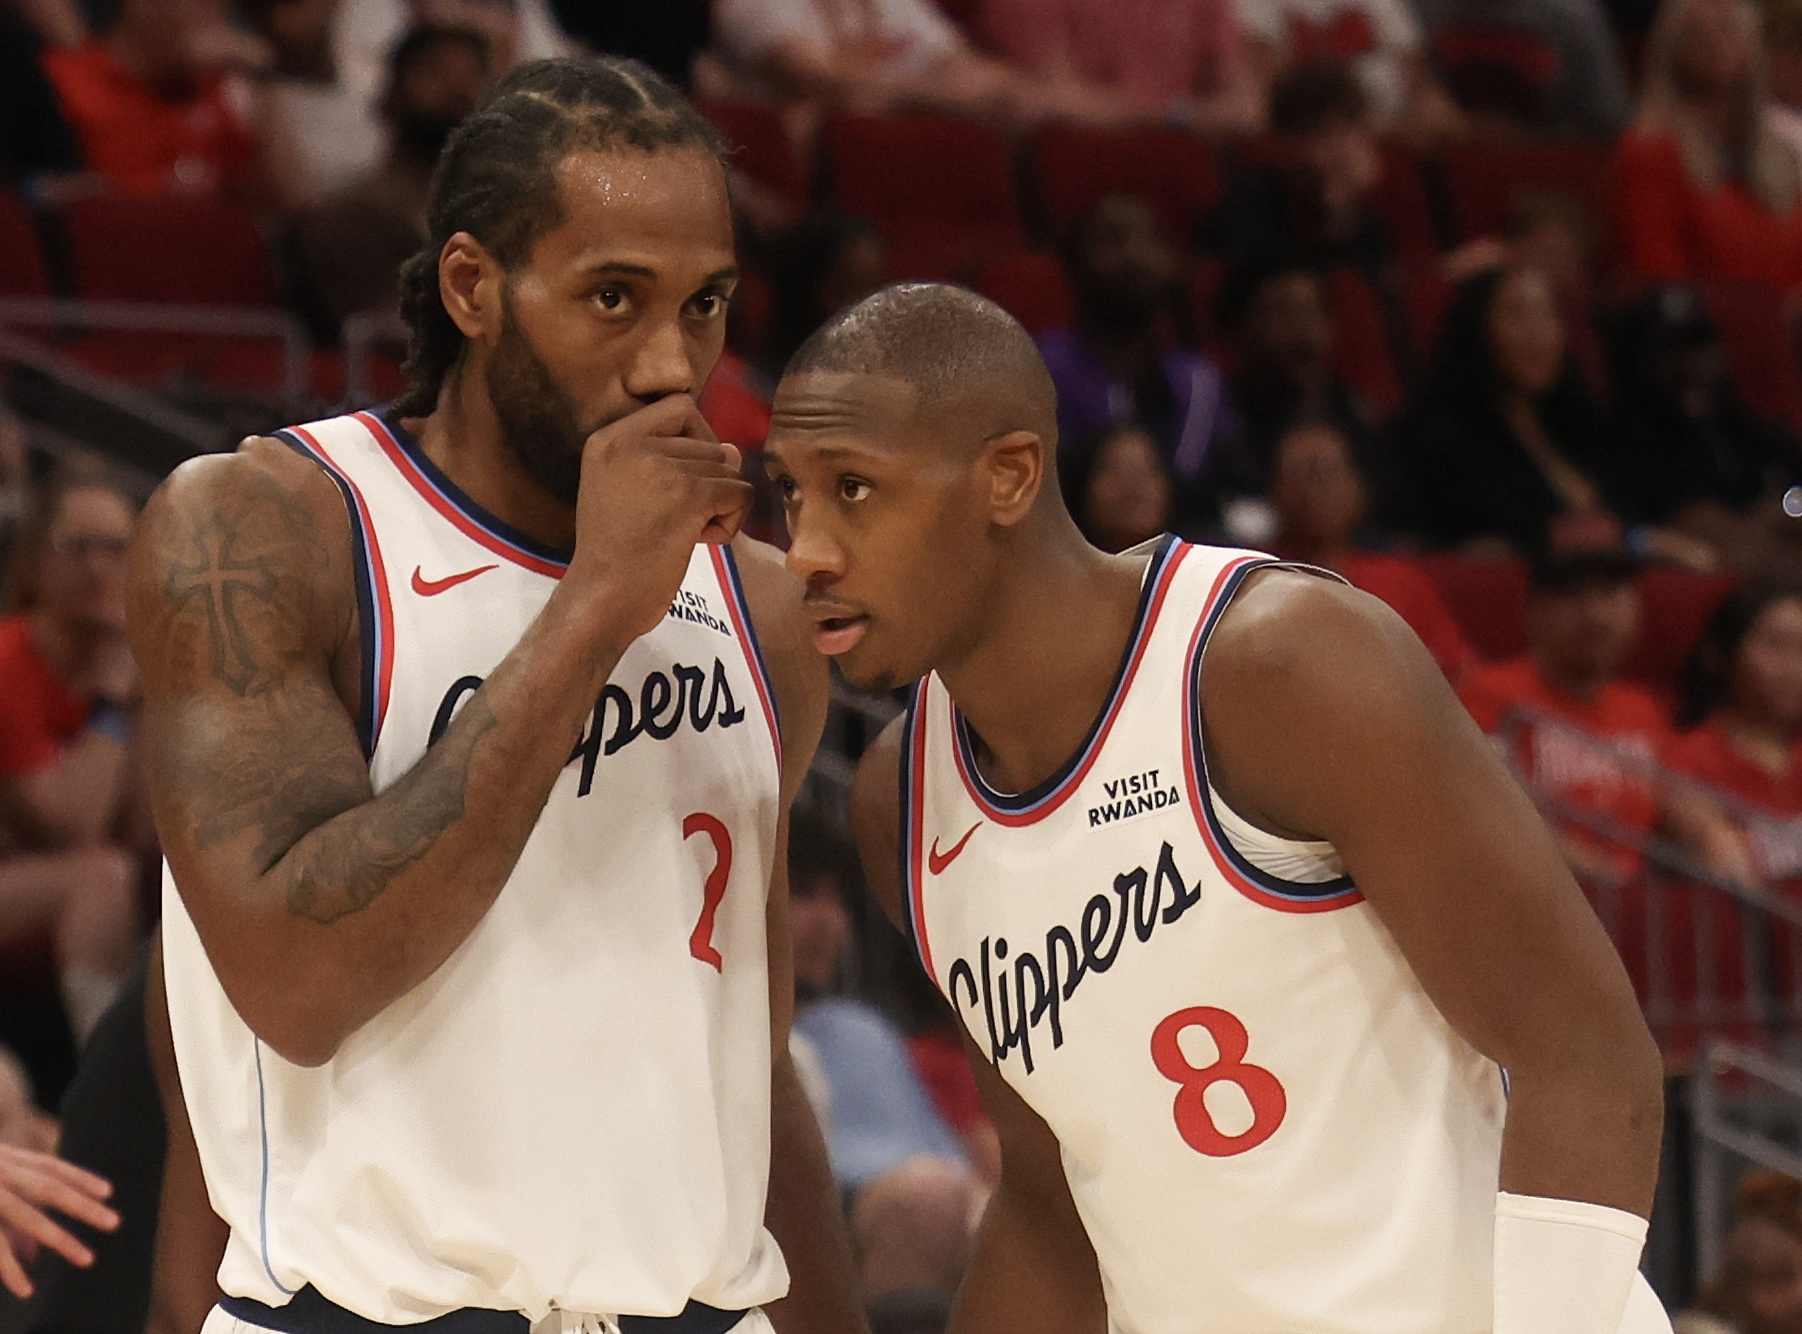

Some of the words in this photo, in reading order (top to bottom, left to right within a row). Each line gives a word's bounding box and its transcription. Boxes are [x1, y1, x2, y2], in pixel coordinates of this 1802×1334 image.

[668, 603, 731, 637] WANDA
[675, 589, 709, 613] ISIT
[427, 656, 745, 798] Cpers
[1088, 786, 1180, 828] RWANDA
[1103, 769, 1159, 799] VISIT
[683, 812, 733, 975] 2
[948, 841, 1202, 1076] Clippers
[1150, 1006, 1287, 1157] 8
